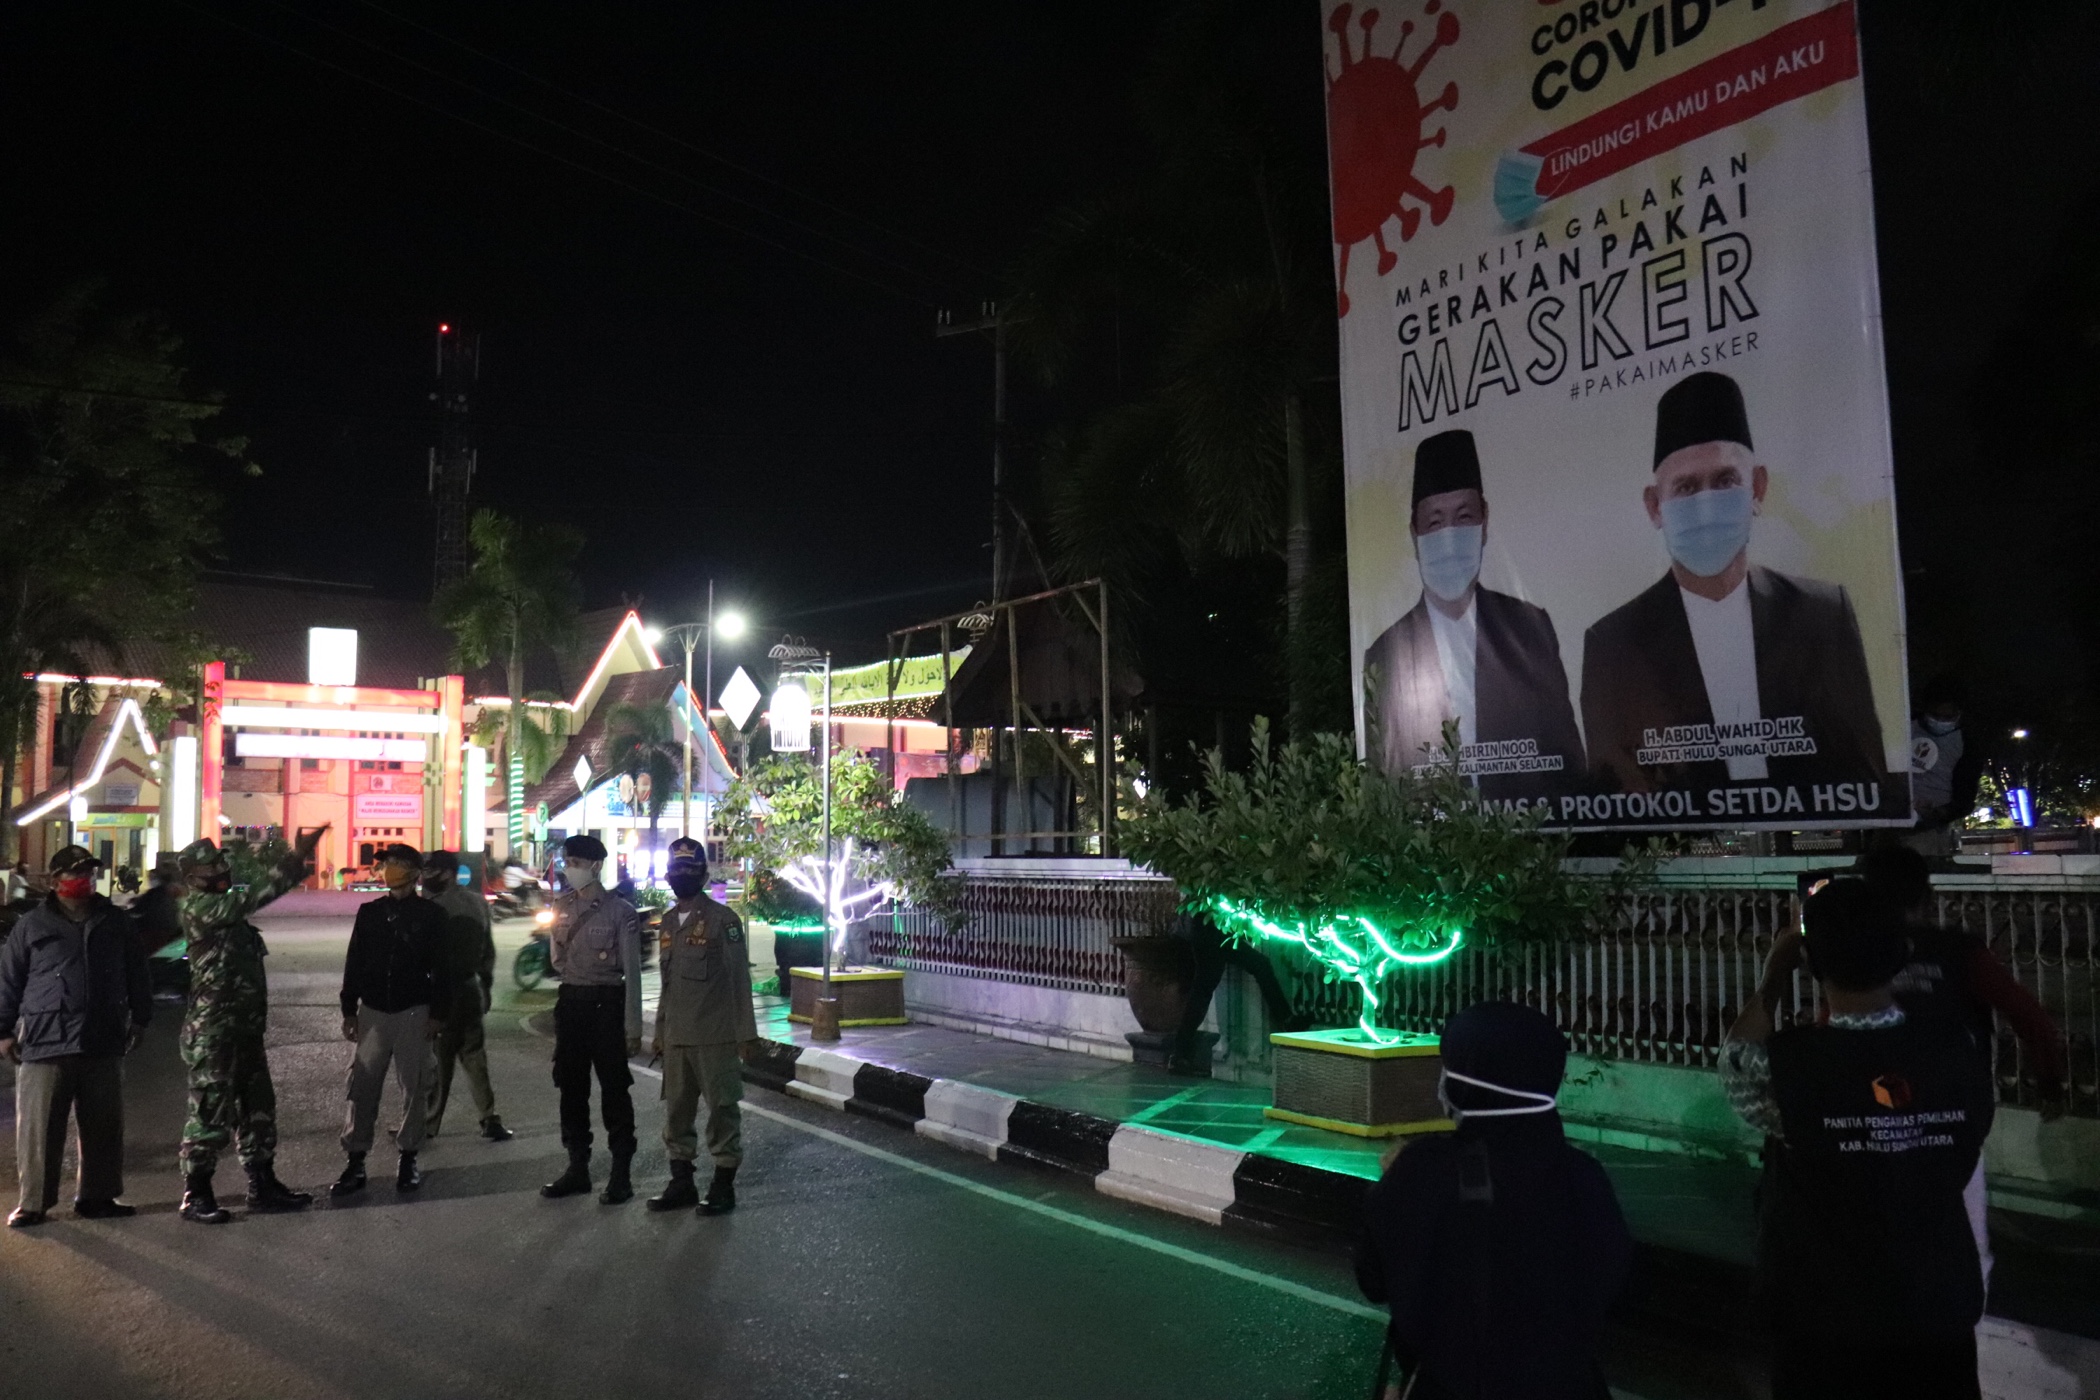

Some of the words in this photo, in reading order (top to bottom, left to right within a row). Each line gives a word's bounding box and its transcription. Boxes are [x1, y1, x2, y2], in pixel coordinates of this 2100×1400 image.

[1531, 0, 1637, 55] CORO
[1551, 120, 1641, 176] LINDUNGI
[1646, 89, 1709, 134] KAMU
[1715, 65, 1768, 105] DAN
[1774, 40, 1825, 79] AKU
[1395, 263, 1465, 307] MARI
[1478, 231, 1549, 274] KITA
[1565, 152, 1748, 239] GALAKAN
[1398, 247, 1581, 346] GERAKAN
[1602, 182, 1748, 270] PAKAI
[1397, 231, 1760, 433] MASKER
[1569, 331, 1760, 401] #PAKAIMASKER
[1501, 740, 1538, 757] NOOR
[1644, 729, 1661, 745] H.
[1664, 725, 1714, 743] ABDUL
[1716, 720, 1774, 740] WAHID
[1777, 718, 1803, 736] HK
[1458, 760, 1518, 775] KALIMANTAN
[1519, 757, 1563, 773] SELATAN
[1638, 748, 1682, 764] BUPATI
[1683, 746, 1716, 761] HULU
[1718, 743, 1767, 758] SUNGAI
[1770, 739, 1815, 755] UTARA
[1560, 790, 1701, 821] PROTOKOL
[1706, 785, 1805, 816] SETDA
[1813, 782, 1881, 813] HSU
[1823, 1116, 1863, 1129] PANITIA
[1839, 1140, 1865, 1152] KAB.
[1920, 1134, 1955, 1147] UTARA
